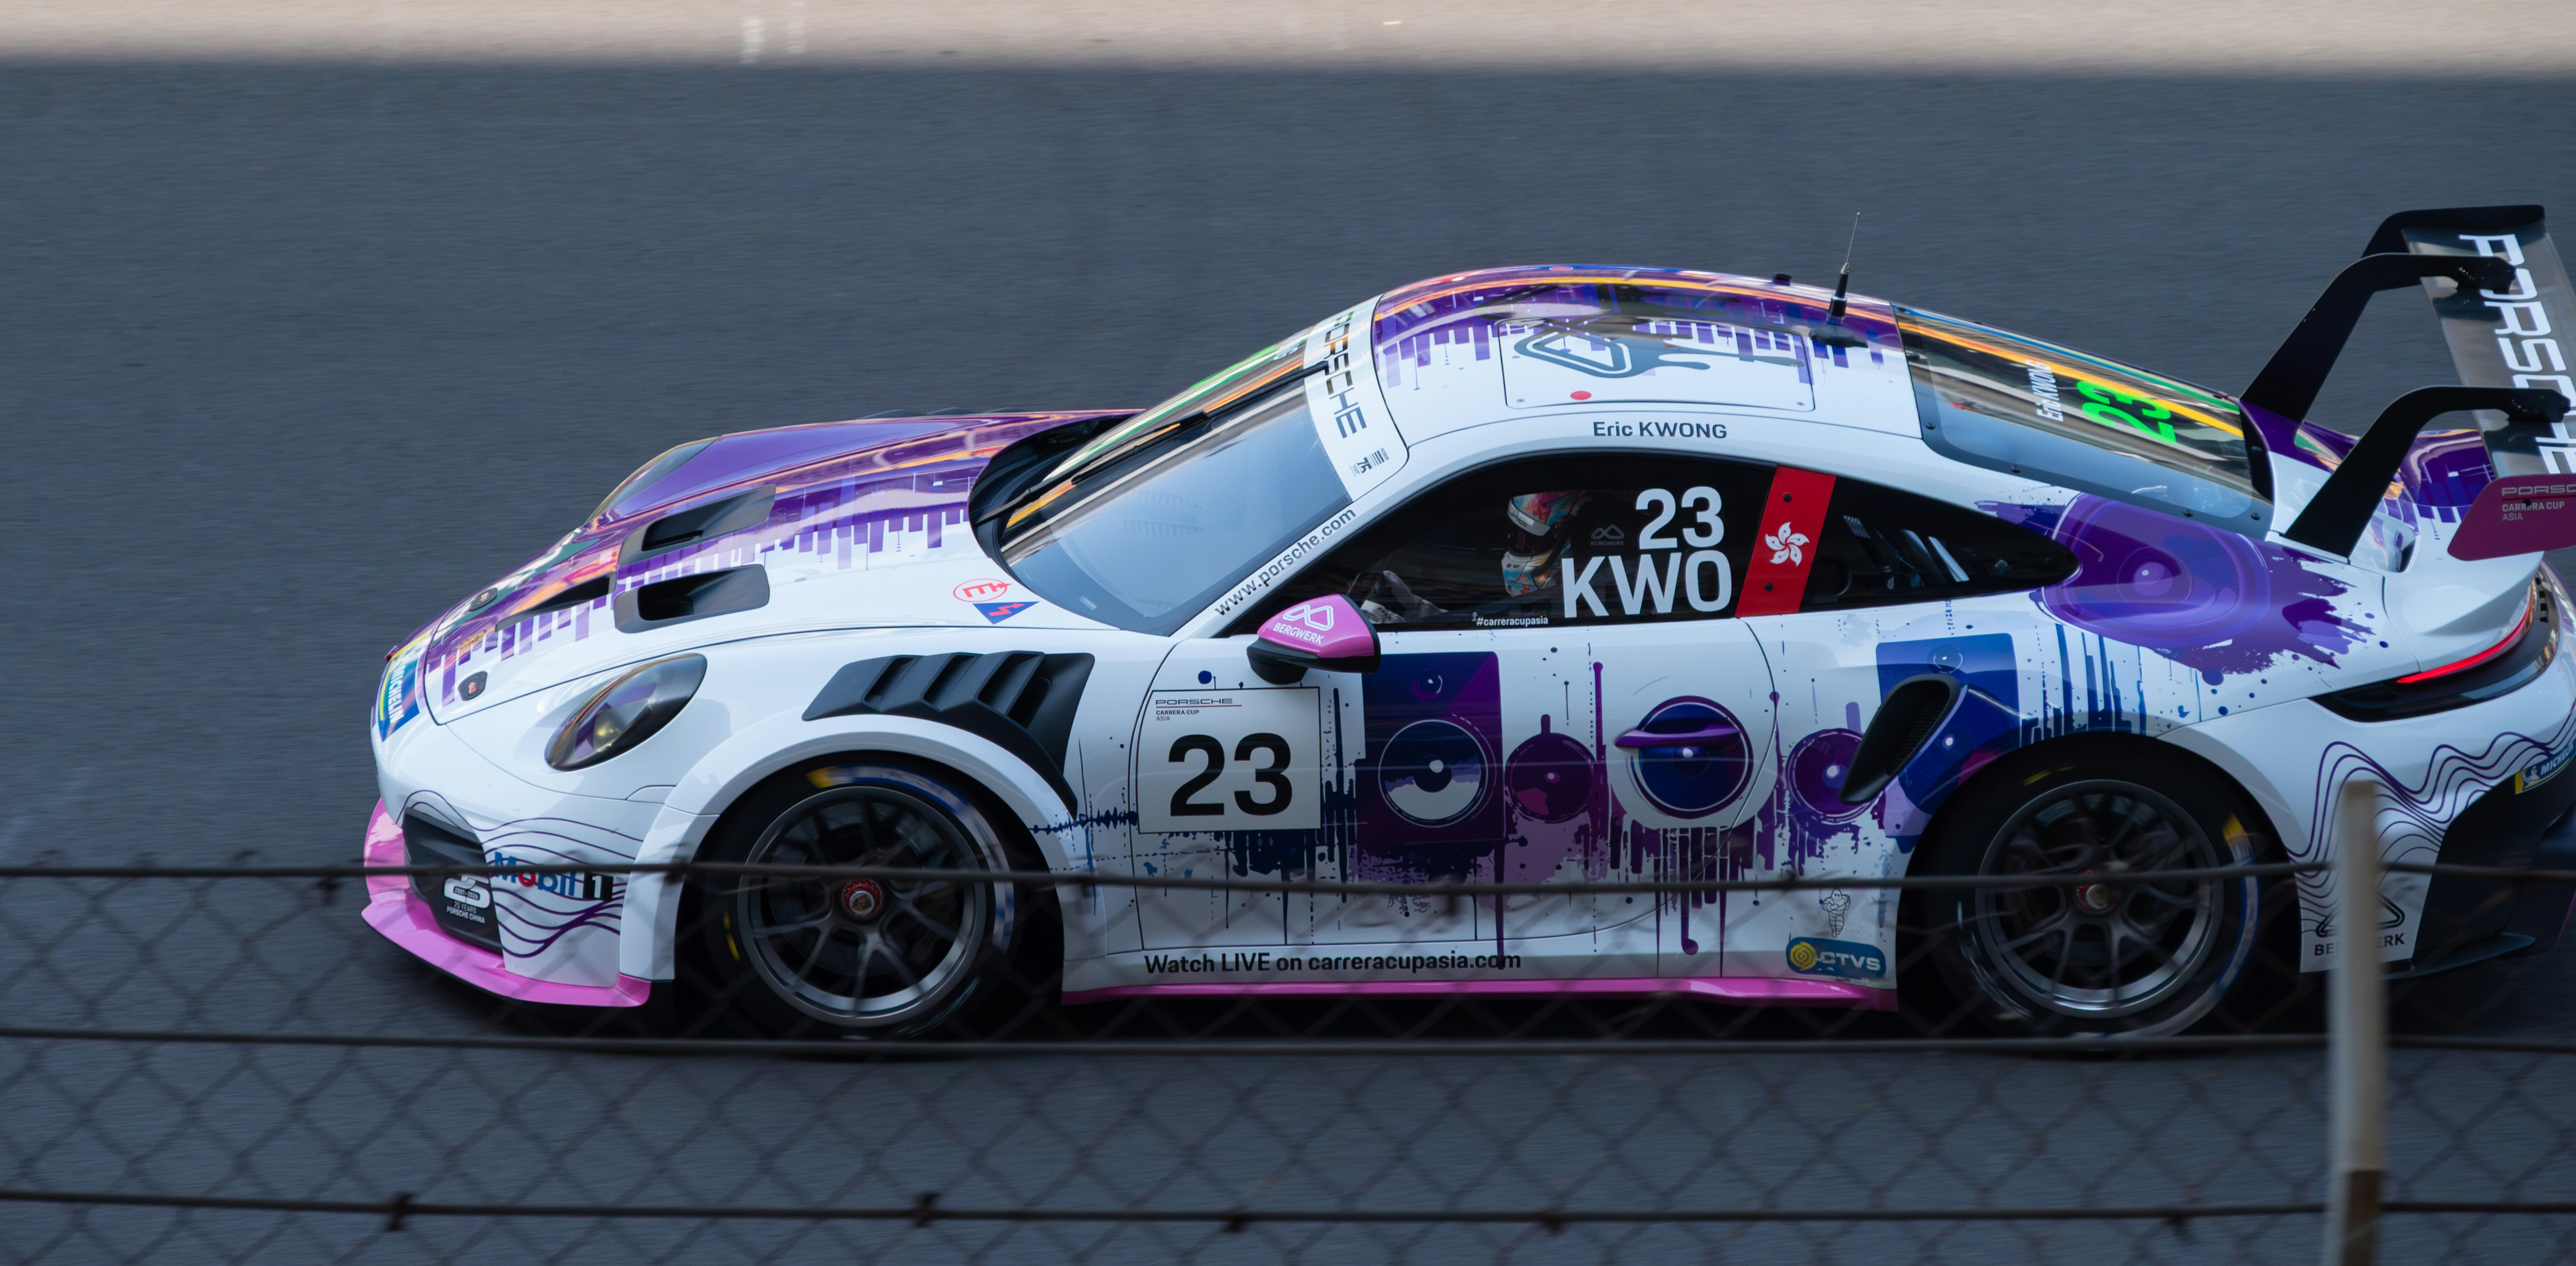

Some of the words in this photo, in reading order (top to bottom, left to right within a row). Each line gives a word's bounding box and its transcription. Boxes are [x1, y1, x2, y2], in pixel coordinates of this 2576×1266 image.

[1324, 311, 1367, 439] PORSCHE
[2024, 359, 2060, 401] KWONG
[2035, 399, 2064, 422] Eric
[2076, 381, 2177, 446] 23
[1593, 422, 1633, 438] Eric
[1639, 422, 1727, 439] KWONG
[1357, 457, 1372, 473] 75
[2502, 484, 2576, 496] PORSC
[2546, 501, 2565, 510] CUP
[1636, 487, 1725, 550] 23
[2503, 513, 2523, 521] ASIA
[1215, 509, 1356, 615] www.porsche.com
[1562, 550, 1732, 618] KWO
[1477, 616, 1548, 627] #carreracupasia
[1273, 622, 1324, 644] BERGWERK
[388, 663, 405, 723] MICHELIN
[1168, 732, 1292, 816] 23
[455, 887, 479, 900] 2001-2026
[592, 876, 602, 898] 1
[446, 906, 468, 919] PORSCHE
[469, 913, 485, 924] CHINA
[454, 901, 460, 909] 25
[461, 903, 477, 914] YEARS
[1144, 954, 1214, 973] Watch
[1222, 953, 1270, 971] LIVE
[1277, 958, 1302, 970] on
[1309, 950, 1521, 972] carreracupasia.com
